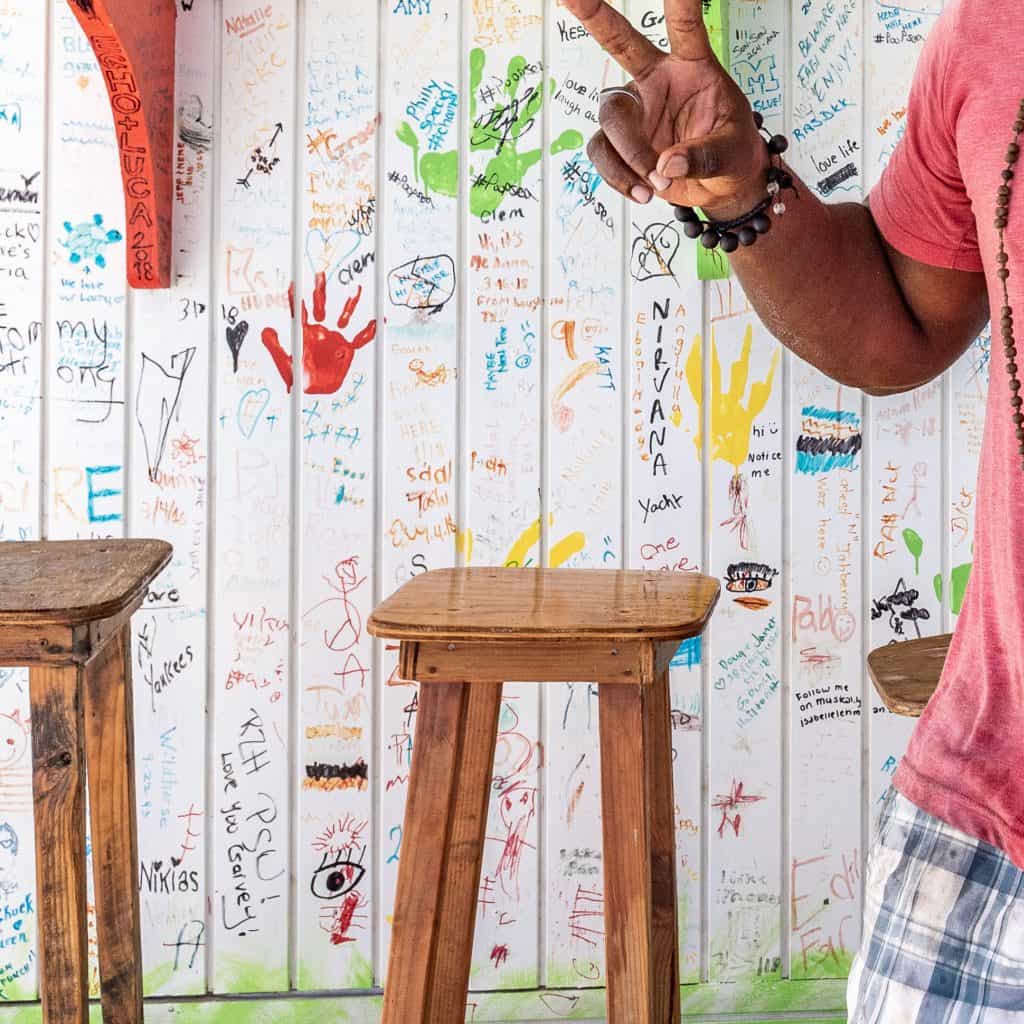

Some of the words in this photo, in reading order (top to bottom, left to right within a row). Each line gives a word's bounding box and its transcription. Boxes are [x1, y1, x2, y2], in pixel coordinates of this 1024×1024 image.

[405, 79, 442, 121] Philly
[841, 138, 861, 159] life
[649, 297, 671, 477] NIRVANA
[752, 420, 765, 437] hi
[747, 450, 783, 463] Notice
[751, 468, 771, 478] me
[794, 684, 832, 702] Follow
[834, 683, 849, 694] me
[799, 697, 815, 712] on
